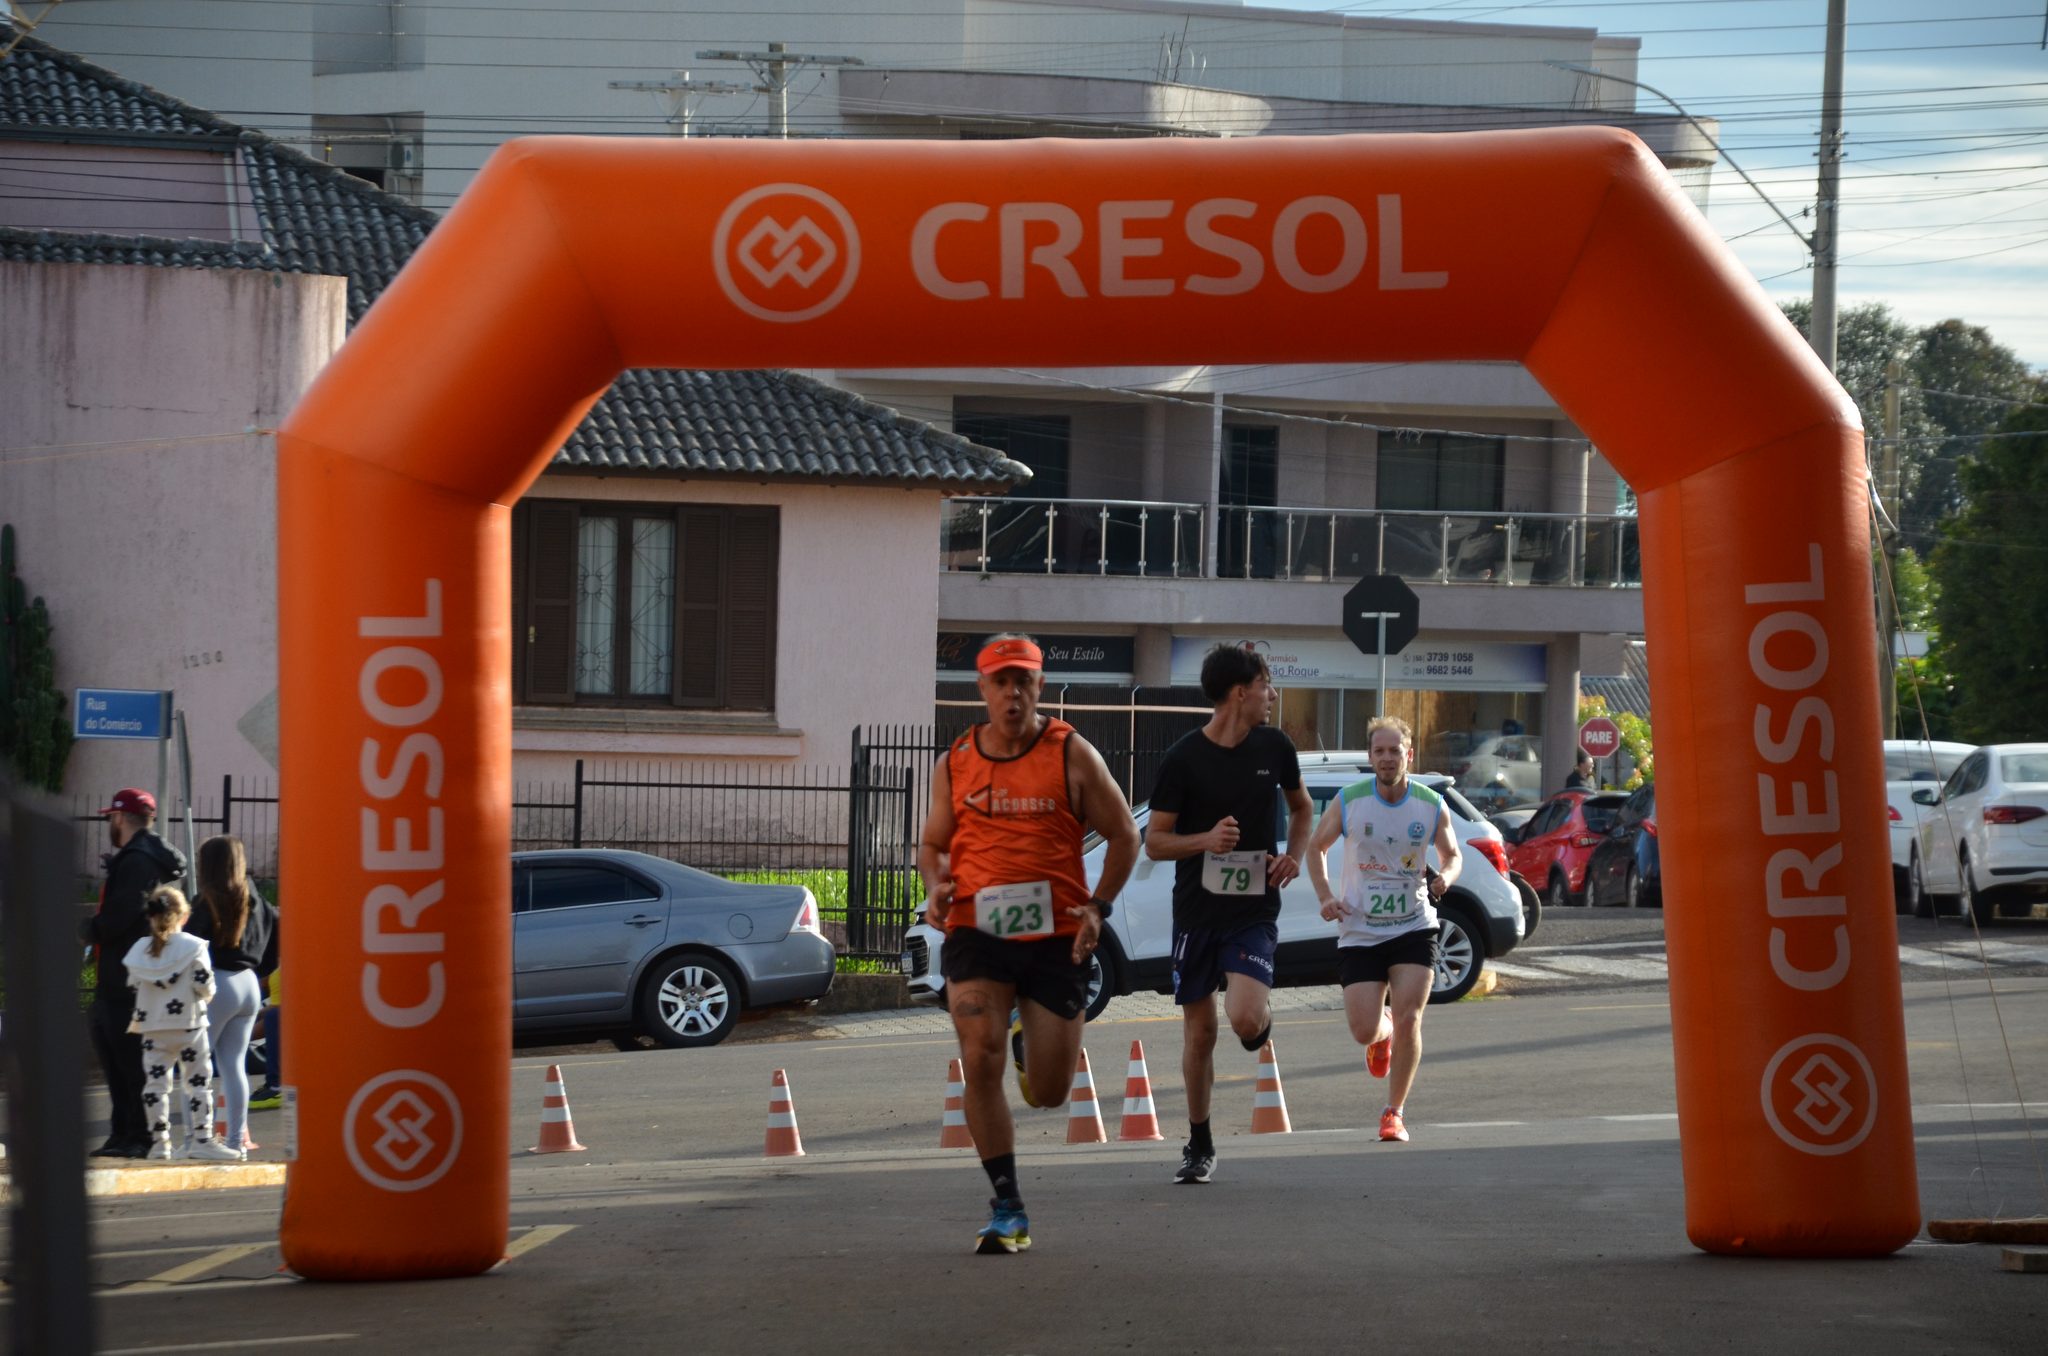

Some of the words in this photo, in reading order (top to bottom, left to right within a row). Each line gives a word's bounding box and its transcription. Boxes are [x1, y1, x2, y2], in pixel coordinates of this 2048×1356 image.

[910, 194, 1449, 301] CRESOL
[1048, 646, 1069, 660] Seu
[1072, 646, 1105, 661] Estilo
[1266, 654, 1298, 663] Farmácia
[1426, 652, 1449, 662] 3739
[1452, 652, 1474, 662] 1058
[1288, 665, 1320, 678] Roque
[1426, 665, 1449, 675] 9682
[1451, 665, 1473, 676] 5446
[86, 697, 107, 711] Rua
[85, 717, 98, 730] do
[98, 717, 143, 731] Comércio
[1585, 731, 1613, 744] PARE
[1744, 542, 1852, 992] CRESOL
[358, 578, 446, 1028] CRESOL
[1220, 867, 1251, 891] 79
[1370, 894, 1407, 914] 241
[988, 903, 1044, 935] 123
